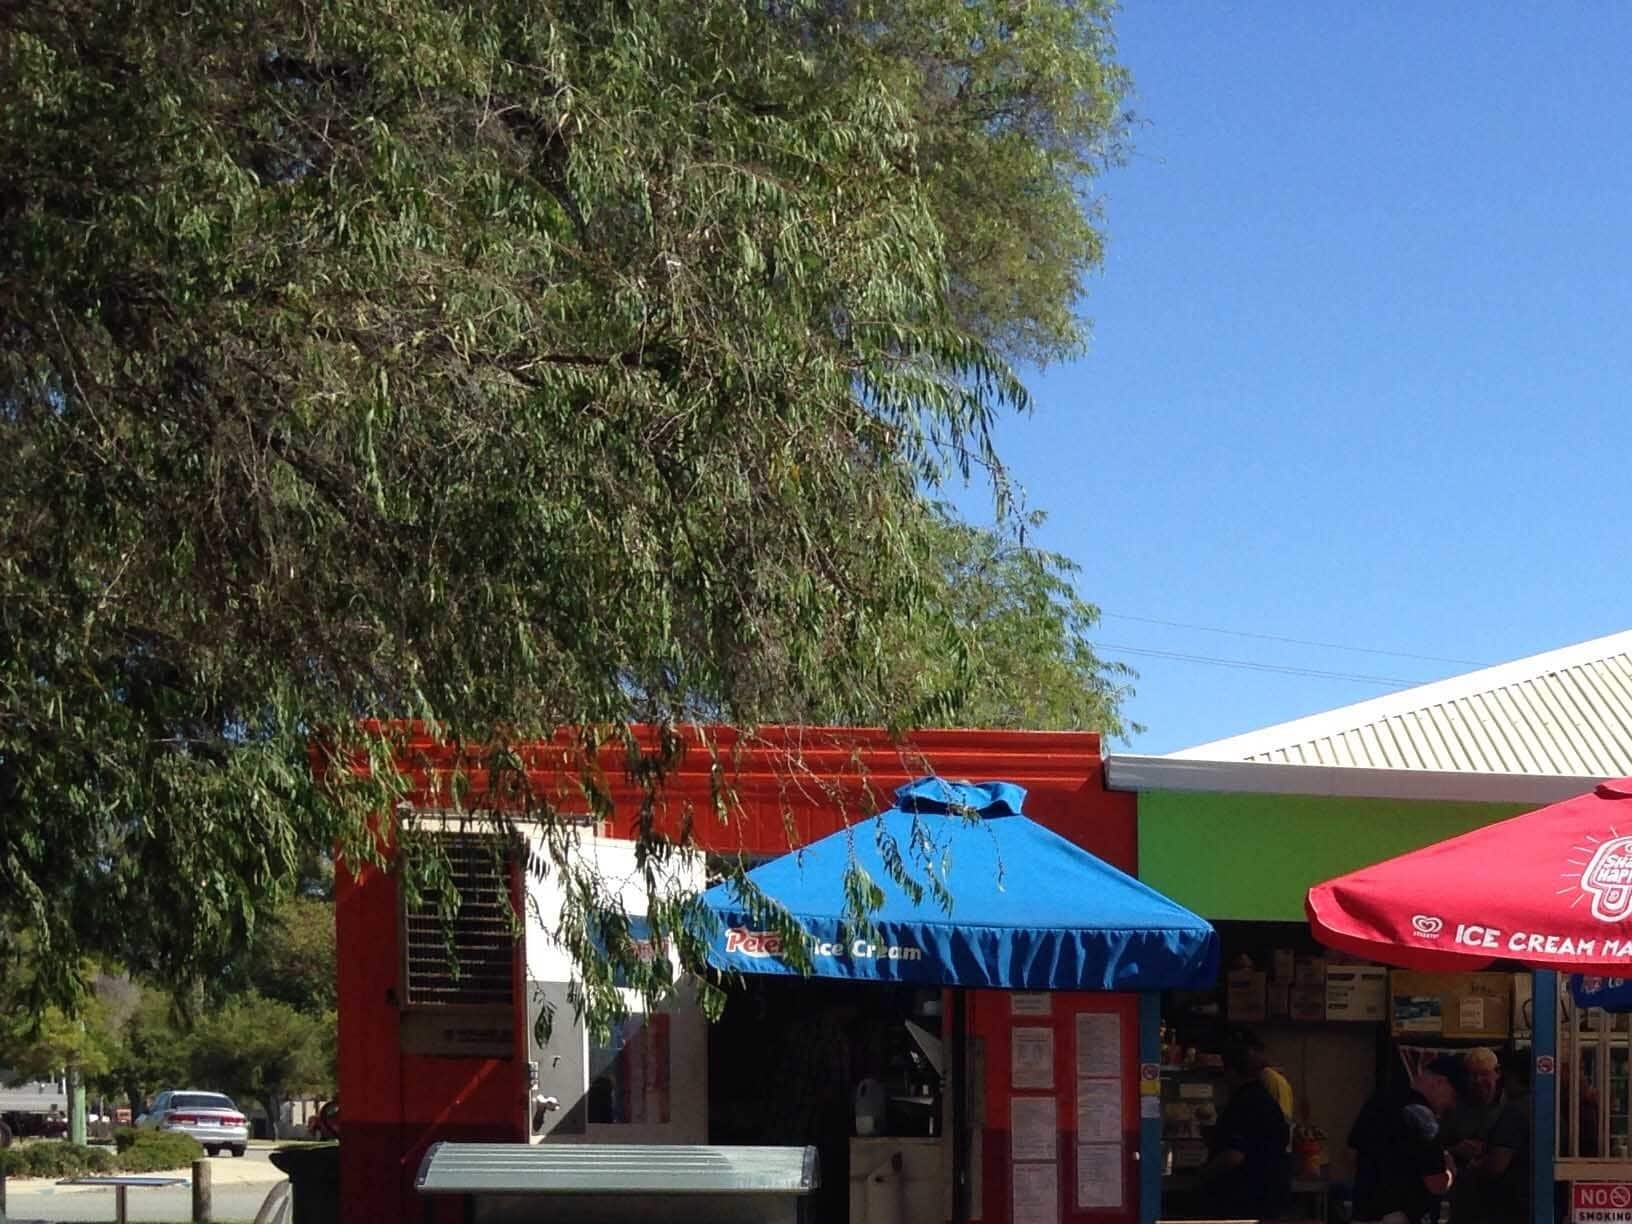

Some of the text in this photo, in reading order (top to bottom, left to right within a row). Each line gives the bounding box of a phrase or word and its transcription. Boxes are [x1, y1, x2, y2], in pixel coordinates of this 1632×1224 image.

[725, 927, 790, 957] Pete
[1456, 924, 1500, 949] ICE
[1508, 932, 1595, 956] CREAM
[1581, 1189, 1607, 1205] NO
[1579, 1211, 1632, 1221] SMOKING
